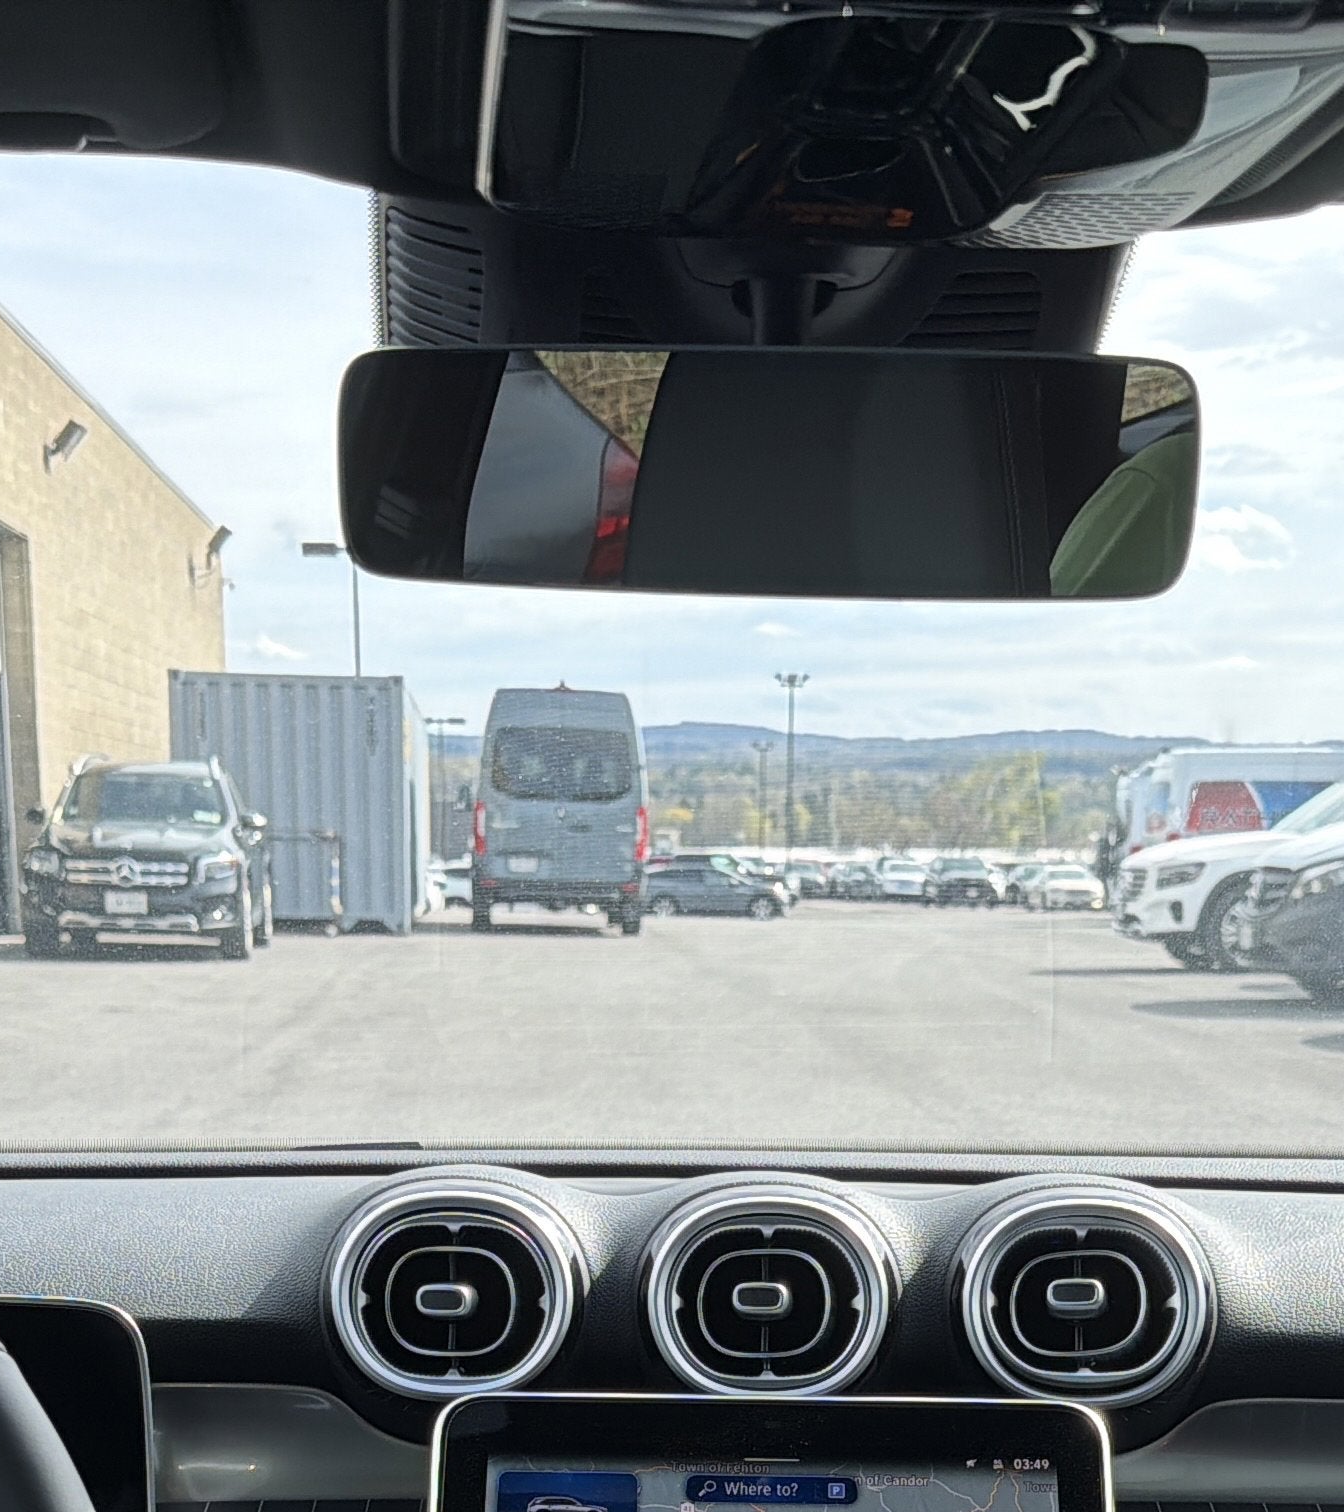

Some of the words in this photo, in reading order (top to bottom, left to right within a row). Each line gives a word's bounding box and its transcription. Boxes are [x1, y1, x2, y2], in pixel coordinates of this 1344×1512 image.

[671, 1462, 704, 1473] Town
[1013, 1459, 1050, 1470] 03:49
[866, 1475, 881, 1486] of
[883, 1475, 929, 1487] Candor
[724, 1482, 772, 1497] Where
[776, 1484, 799, 1496] to?
